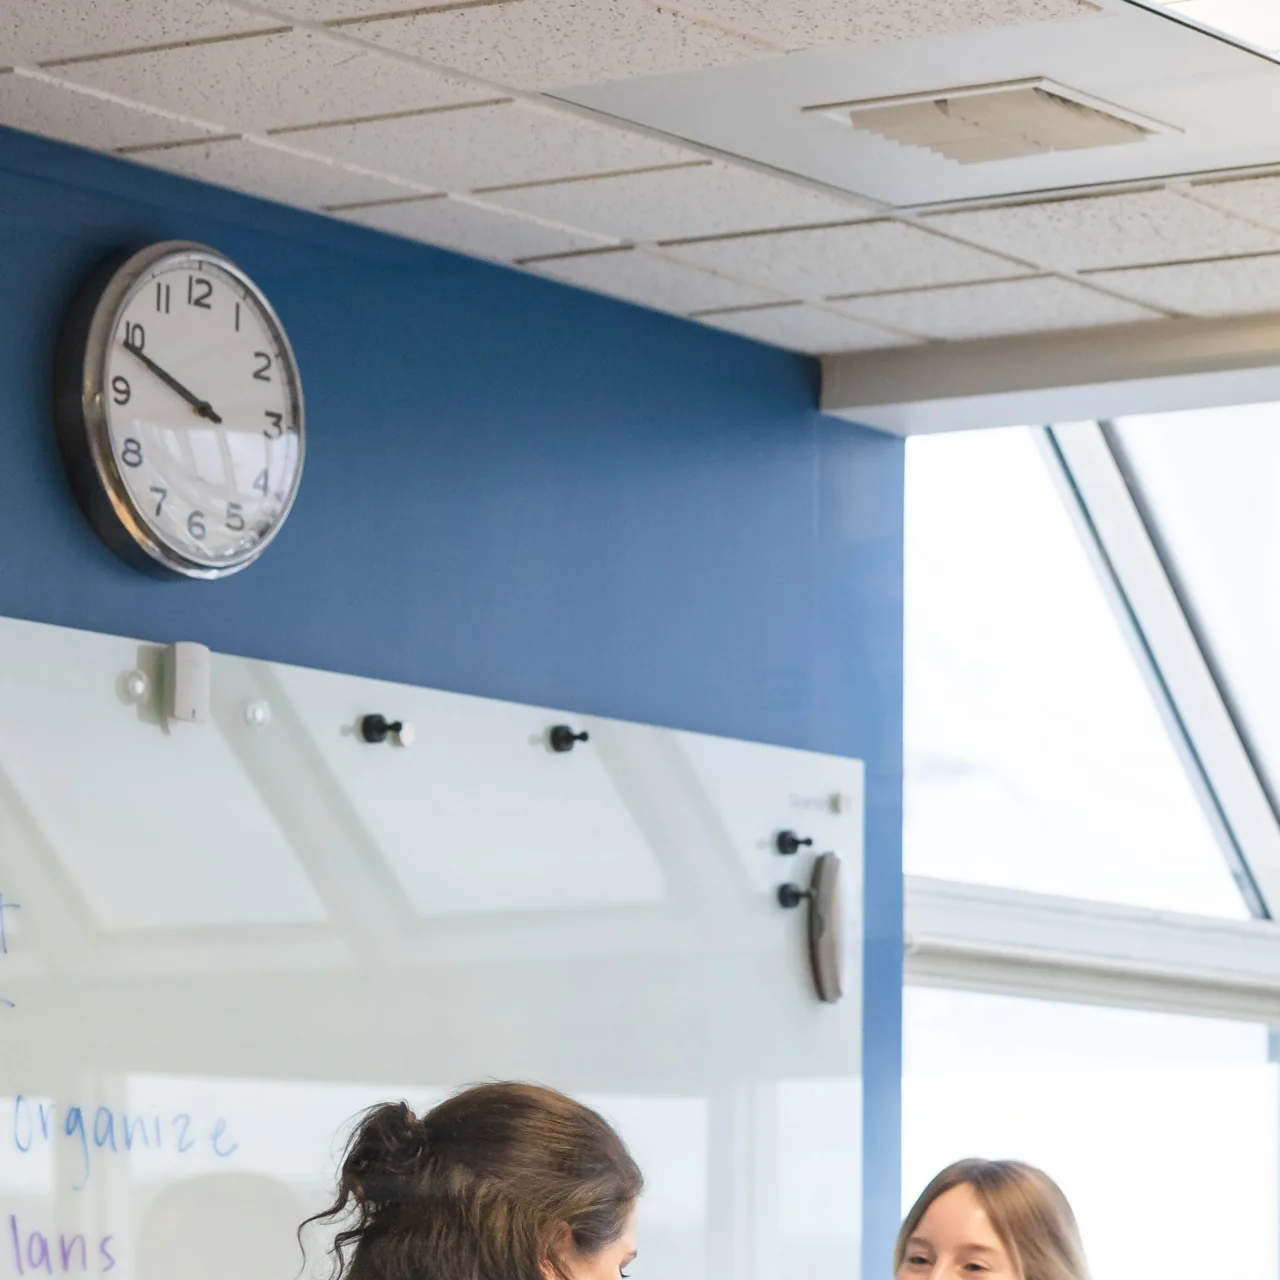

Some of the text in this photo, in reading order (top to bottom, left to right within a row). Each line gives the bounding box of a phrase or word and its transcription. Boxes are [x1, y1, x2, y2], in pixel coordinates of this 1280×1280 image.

[156, 281, 171, 315] 11
[187, 274, 213, 310] 12
[234, 302, 241, 333] 1
[124, 319, 146, 351] 10
[252, 351, 273, 383] 2
[111, 375, 132, 406] 9
[263, 410, 283, 440] 3
[121, 438, 144, 468] 8
[252, 467, 271, 498] 4
[149, 486, 169, 517] 7
[225, 502, 246, 532] 5
[187, 510, 207, 541] 6
